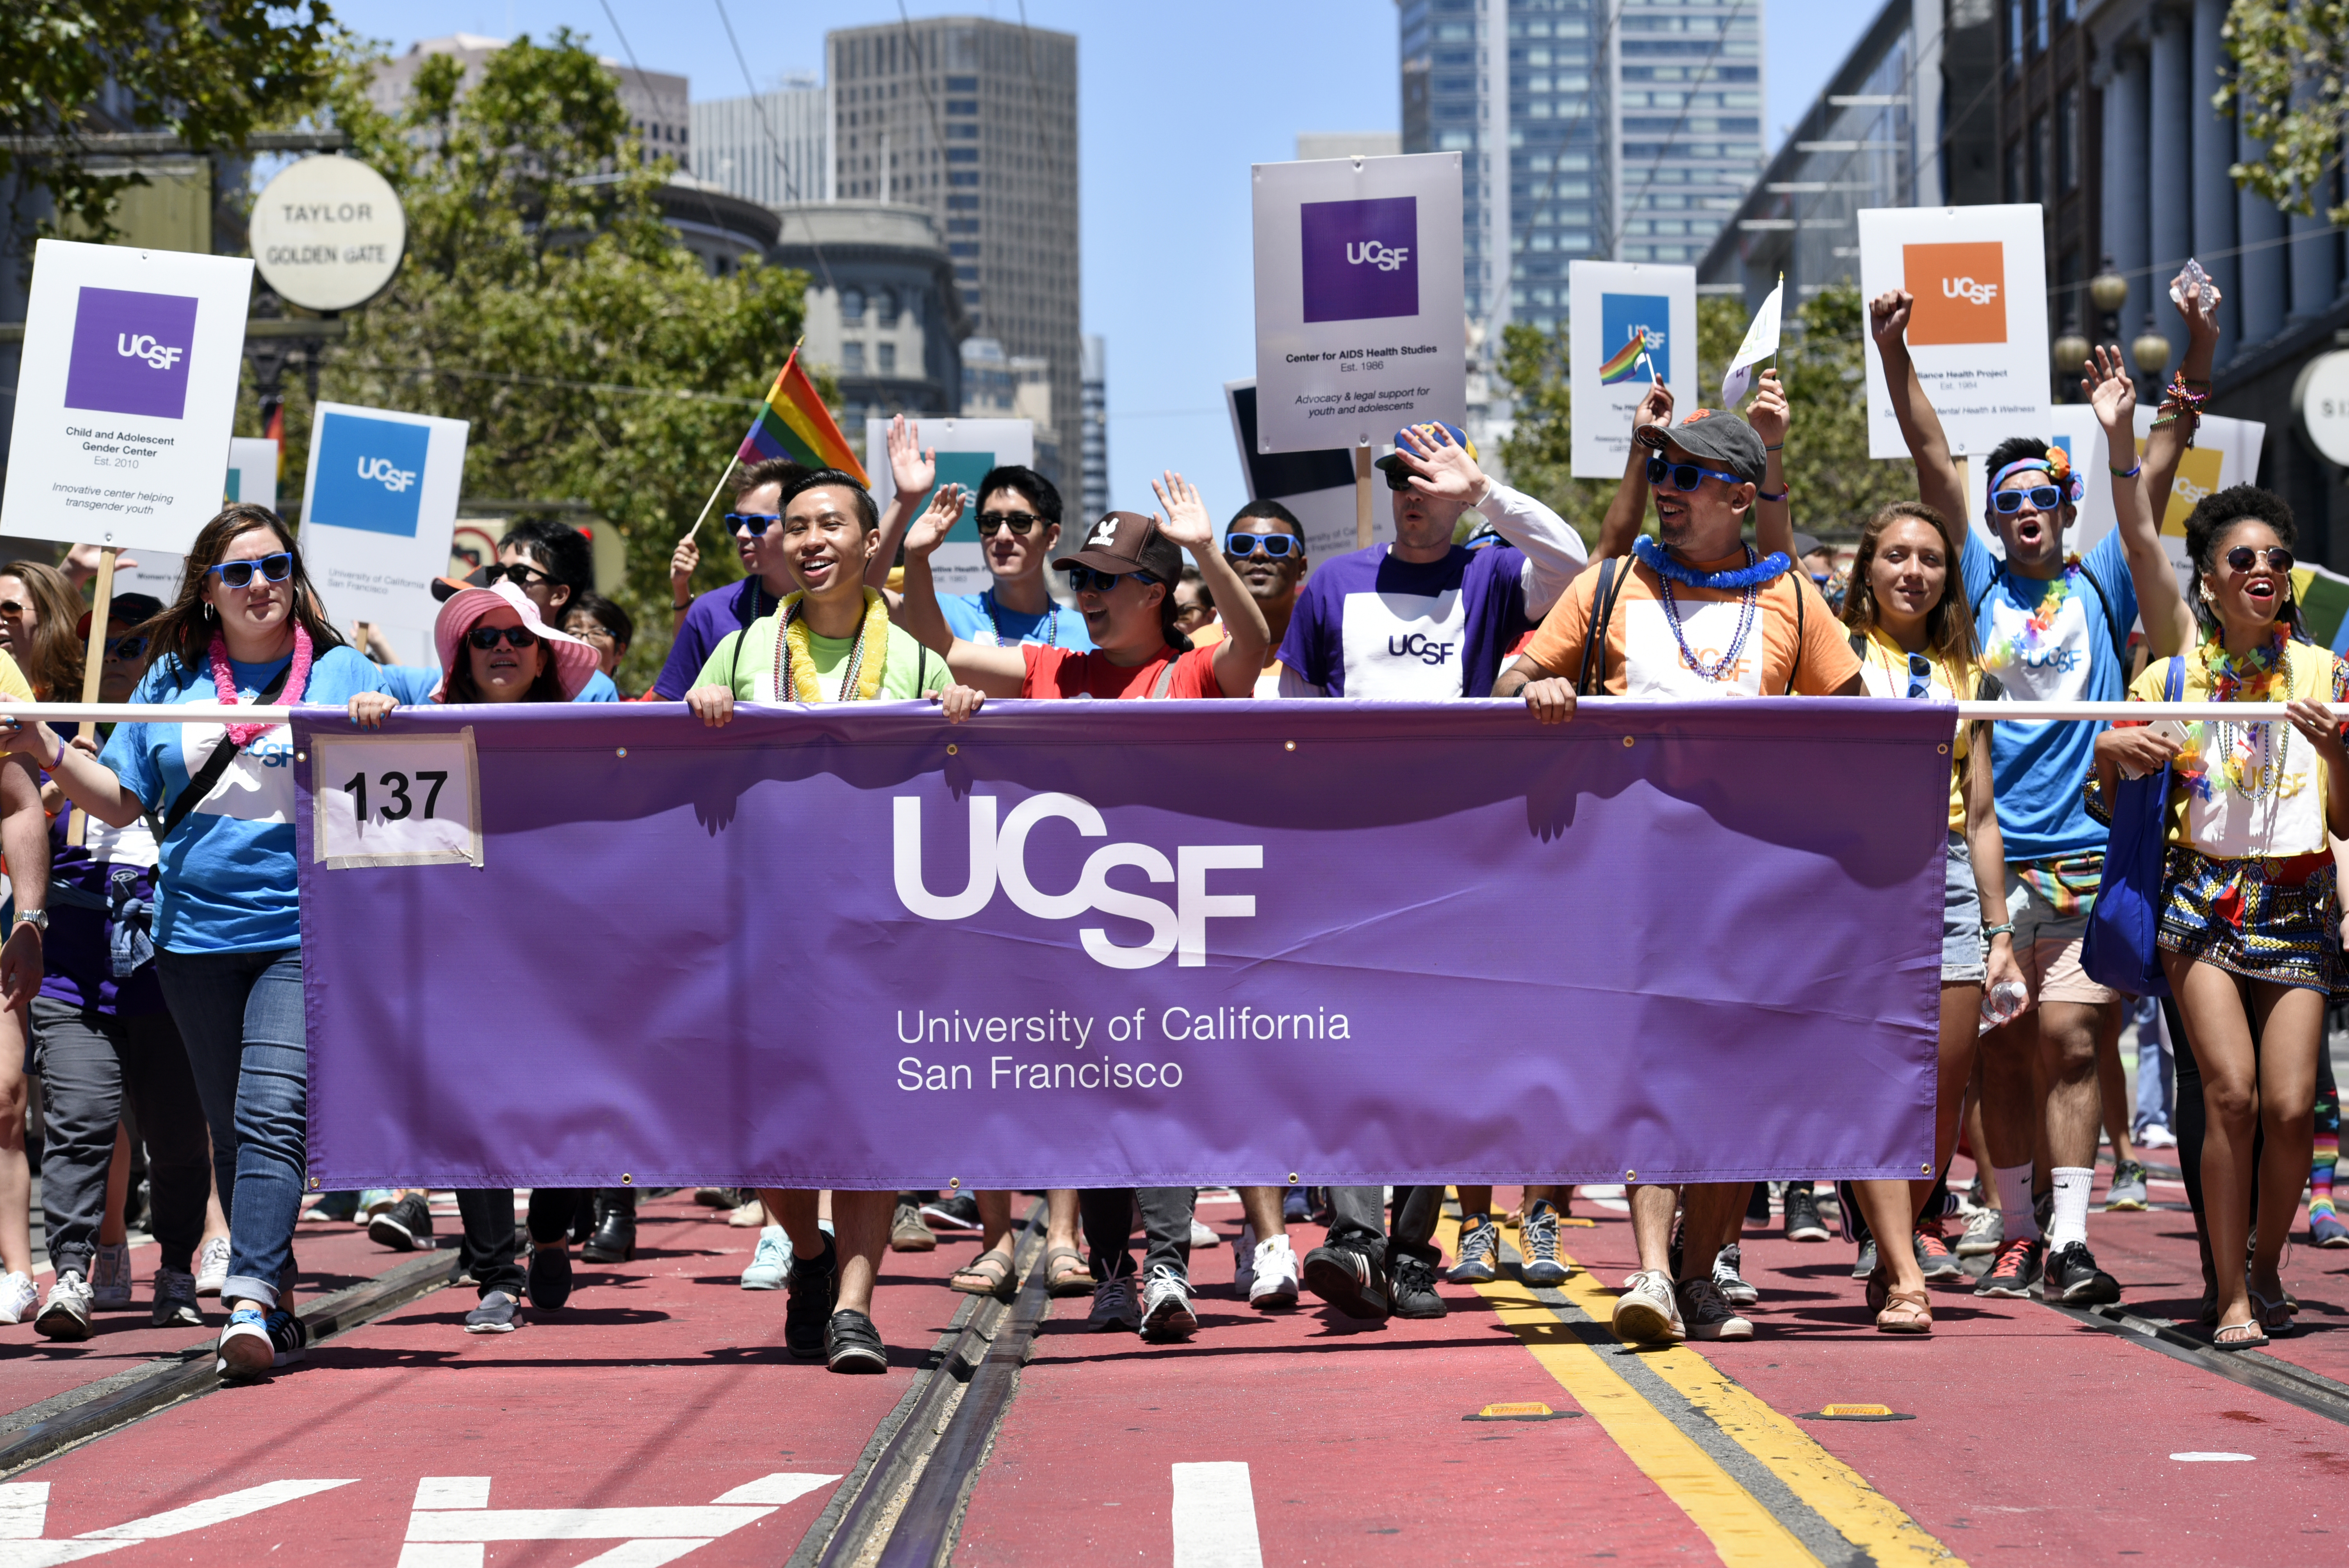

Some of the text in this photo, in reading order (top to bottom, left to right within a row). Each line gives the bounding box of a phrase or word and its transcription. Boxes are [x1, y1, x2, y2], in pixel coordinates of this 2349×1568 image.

[281, 203, 372, 223] TAYLOR
[267, 244, 387, 265] GOLDEN GATE
[1347, 240, 1408, 271] UCSF
[1942, 277, 1998, 305] UCSF
[118, 333, 183, 370] UCSF
[1286, 344, 1437, 363] Center for AIDS Health Studies
[1341, 360, 1384, 372] Est. 1986
[1946, 370, 1974, 379] Health
[1977, 369, 2007, 379] Project
[1295, 386, 1431, 406] Advocacy & legal support for
[1308, 401, 1414, 418] youth and adolescents
[2320, 397, 2349, 419] SI
[66, 426, 175, 446] Child and Adolescent
[82, 442, 157, 457] Gender Center
[94, 456, 139, 469] Est. 2010
[357, 456, 416, 492] UCSF
[52, 482, 173, 505] Innovative center helping
[66, 497, 153, 515] transgender youth
[327, 577, 389, 595] San Francisco
[328, 567, 425, 590] University of California
[1388, 633, 1454, 665] UCSF
[2027, 646, 2082, 674] UCSF
[2237, 764, 2307, 799] UCSF
[344, 771, 448, 821] 137
[893, 792, 1264, 969] UCSF
[897, 1006, 1351, 1049] University of California
[897, 1055, 1183, 1091] San Francisco
